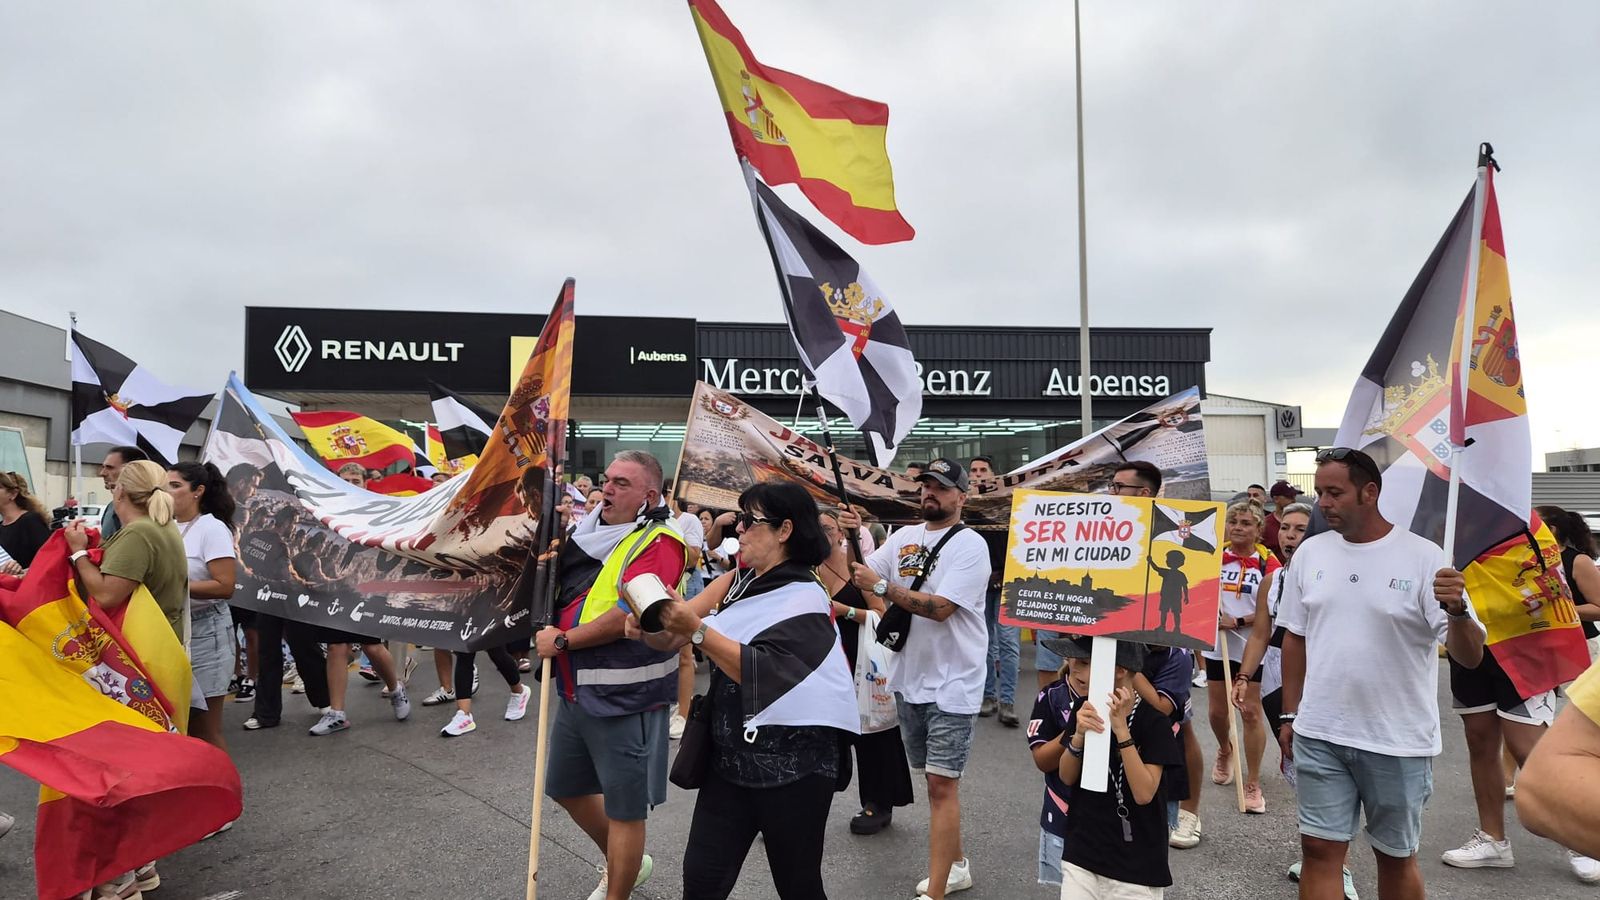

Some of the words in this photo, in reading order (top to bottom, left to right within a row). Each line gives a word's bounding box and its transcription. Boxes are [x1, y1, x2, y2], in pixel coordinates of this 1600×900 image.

[321, 340, 464, 362] RENAULT
[637, 351, 688, 362] Aubensa
[978, 458, 1081, 495] EUTA
[330, 472, 469, 527] PUEB
[1034, 501, 1112, 516] NECESITO
[1023, 520, 1066, 544] SER
[1075, 515, 1134, 542] NIÑO
[250, 547, 267, 561] CEUTA
[1026, 547, 1047, 562] EN
[1052, 547, 1069, 562] MI
[1074, 546, 1131, 562] CIUDAD
[1220, 570, 1259, 585] EUTA
[1018, 589, 1042, 599] CEUTA
[1044, 591, 1053, 600] ES
[1055, 592, 1065, 601] MI
[1066, 593, 1094, 605] HOGAR
[1017, 599, 1058, 611] DEJADNOS
[1060, 604, 1083, 615] VIVIR.
[401, 617, 418, 629] NADA
[417, 619, 431, 629] NOS
[429, 620, 455, 631] DETIENE
[1016, 609, 1053, 620] DEJADNOS
[1055, 613, 1070, 622] SER
[1072, 613, 1097, 625] NIÑOS
